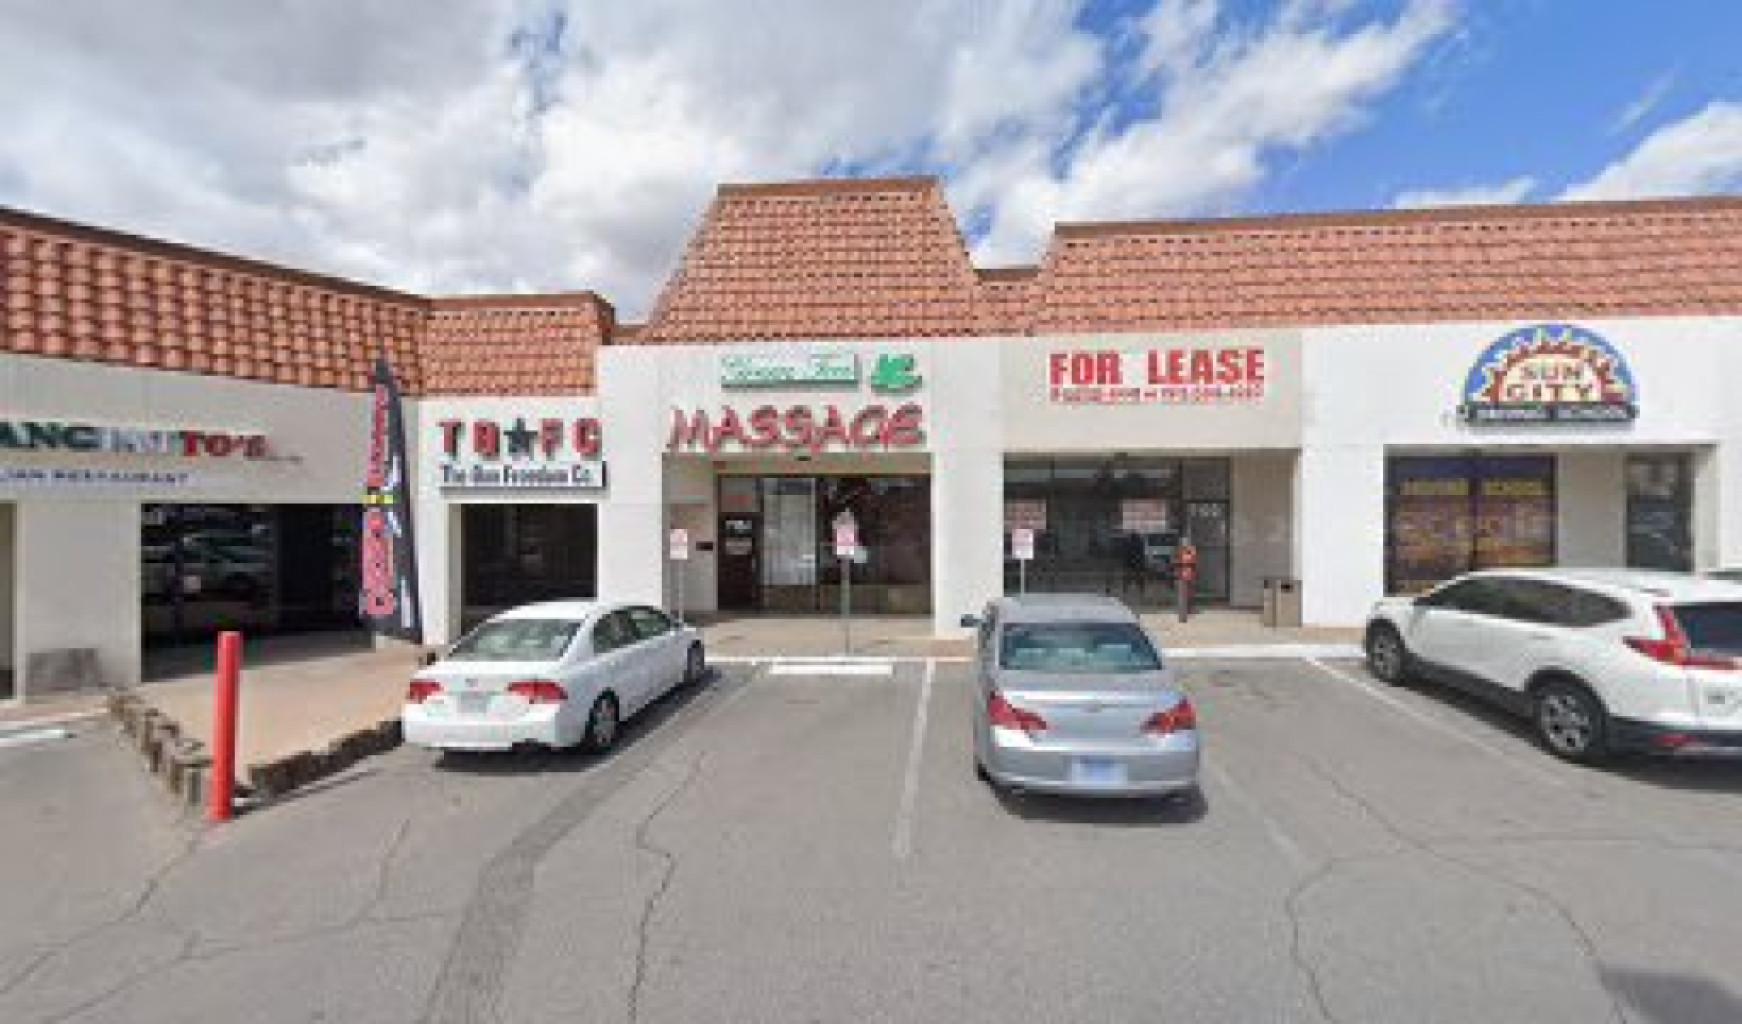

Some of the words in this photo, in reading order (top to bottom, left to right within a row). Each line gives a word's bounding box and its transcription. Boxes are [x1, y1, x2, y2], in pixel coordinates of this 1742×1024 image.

[1050, 352, 1122, 385] FOR
[1147, 349, 1265, 385] LEASE
[1520, 362, 1584, 381] SUN
[1506, 384, 1596, 401] CITY
[666, 403, 927, 452] MASSAGE
